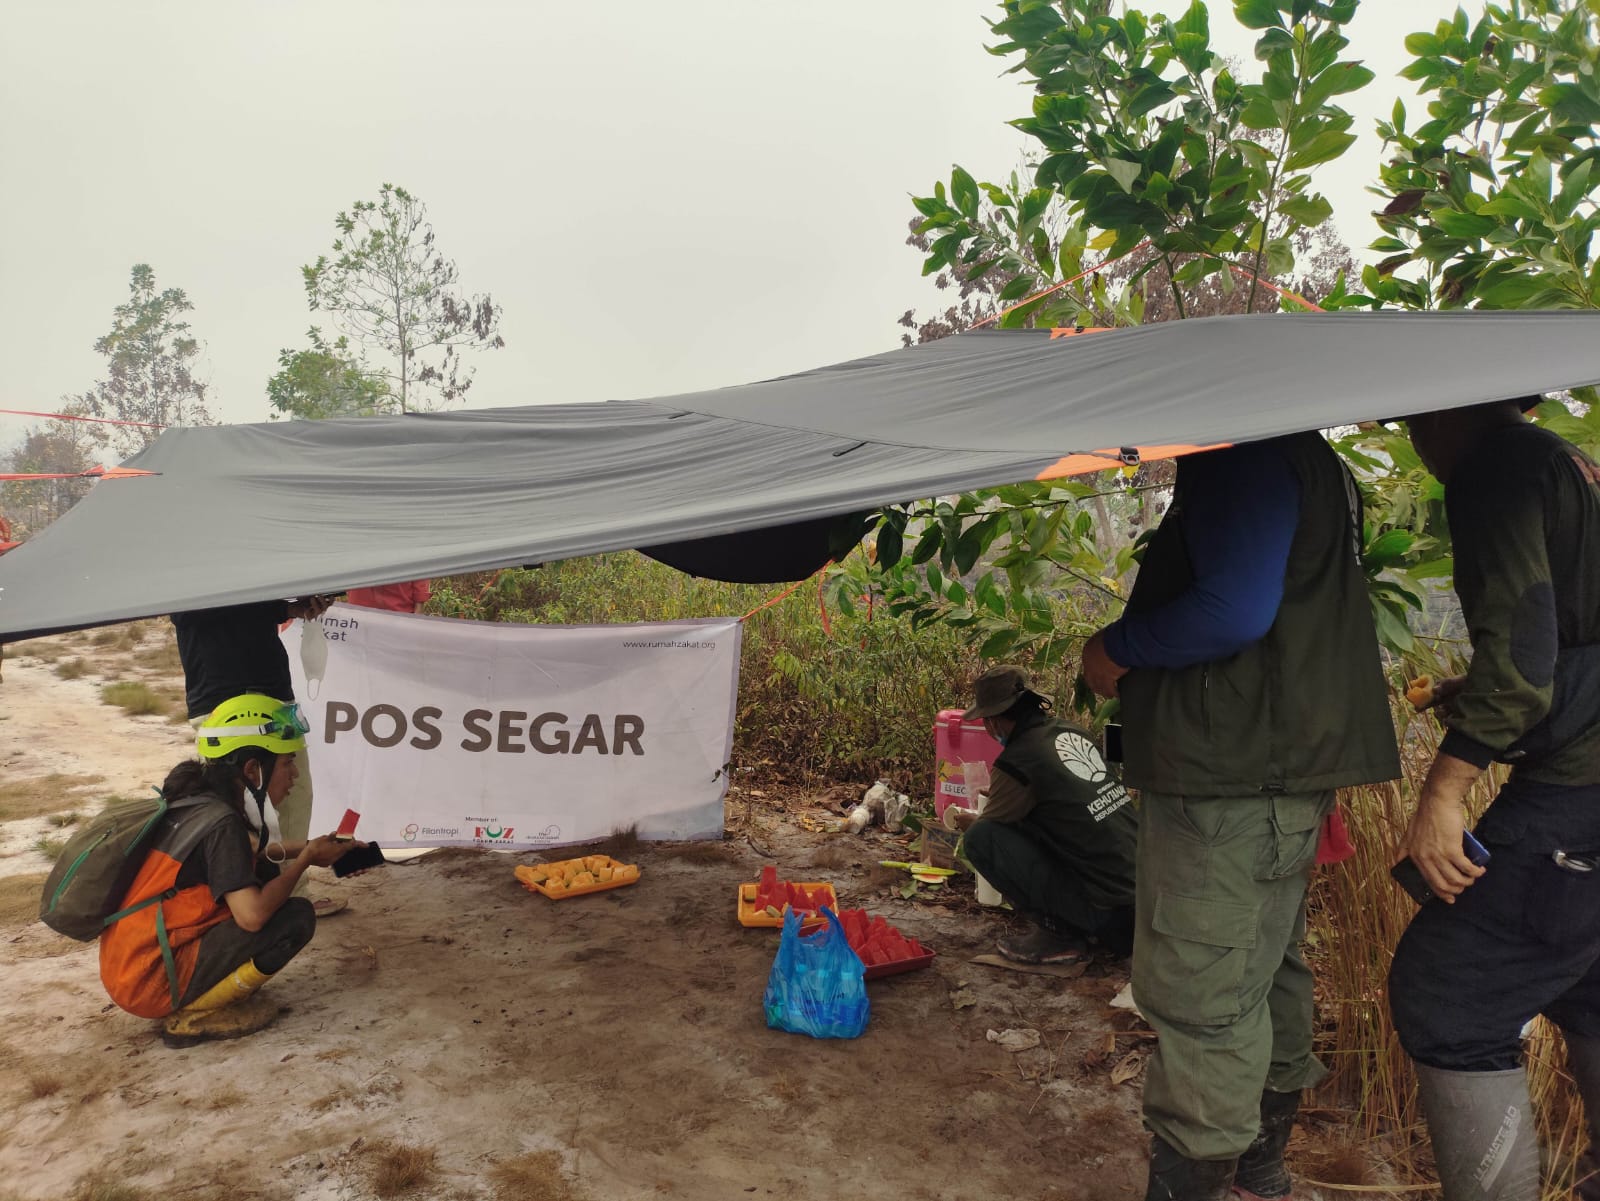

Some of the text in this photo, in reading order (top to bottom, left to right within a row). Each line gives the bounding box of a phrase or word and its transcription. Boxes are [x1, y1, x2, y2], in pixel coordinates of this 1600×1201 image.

[622, 640, 716, 651] www.rumahzakat.org
[324, 701, 645, 755] POS SEGAR
[421, 827, 459, 837] Filantropi
